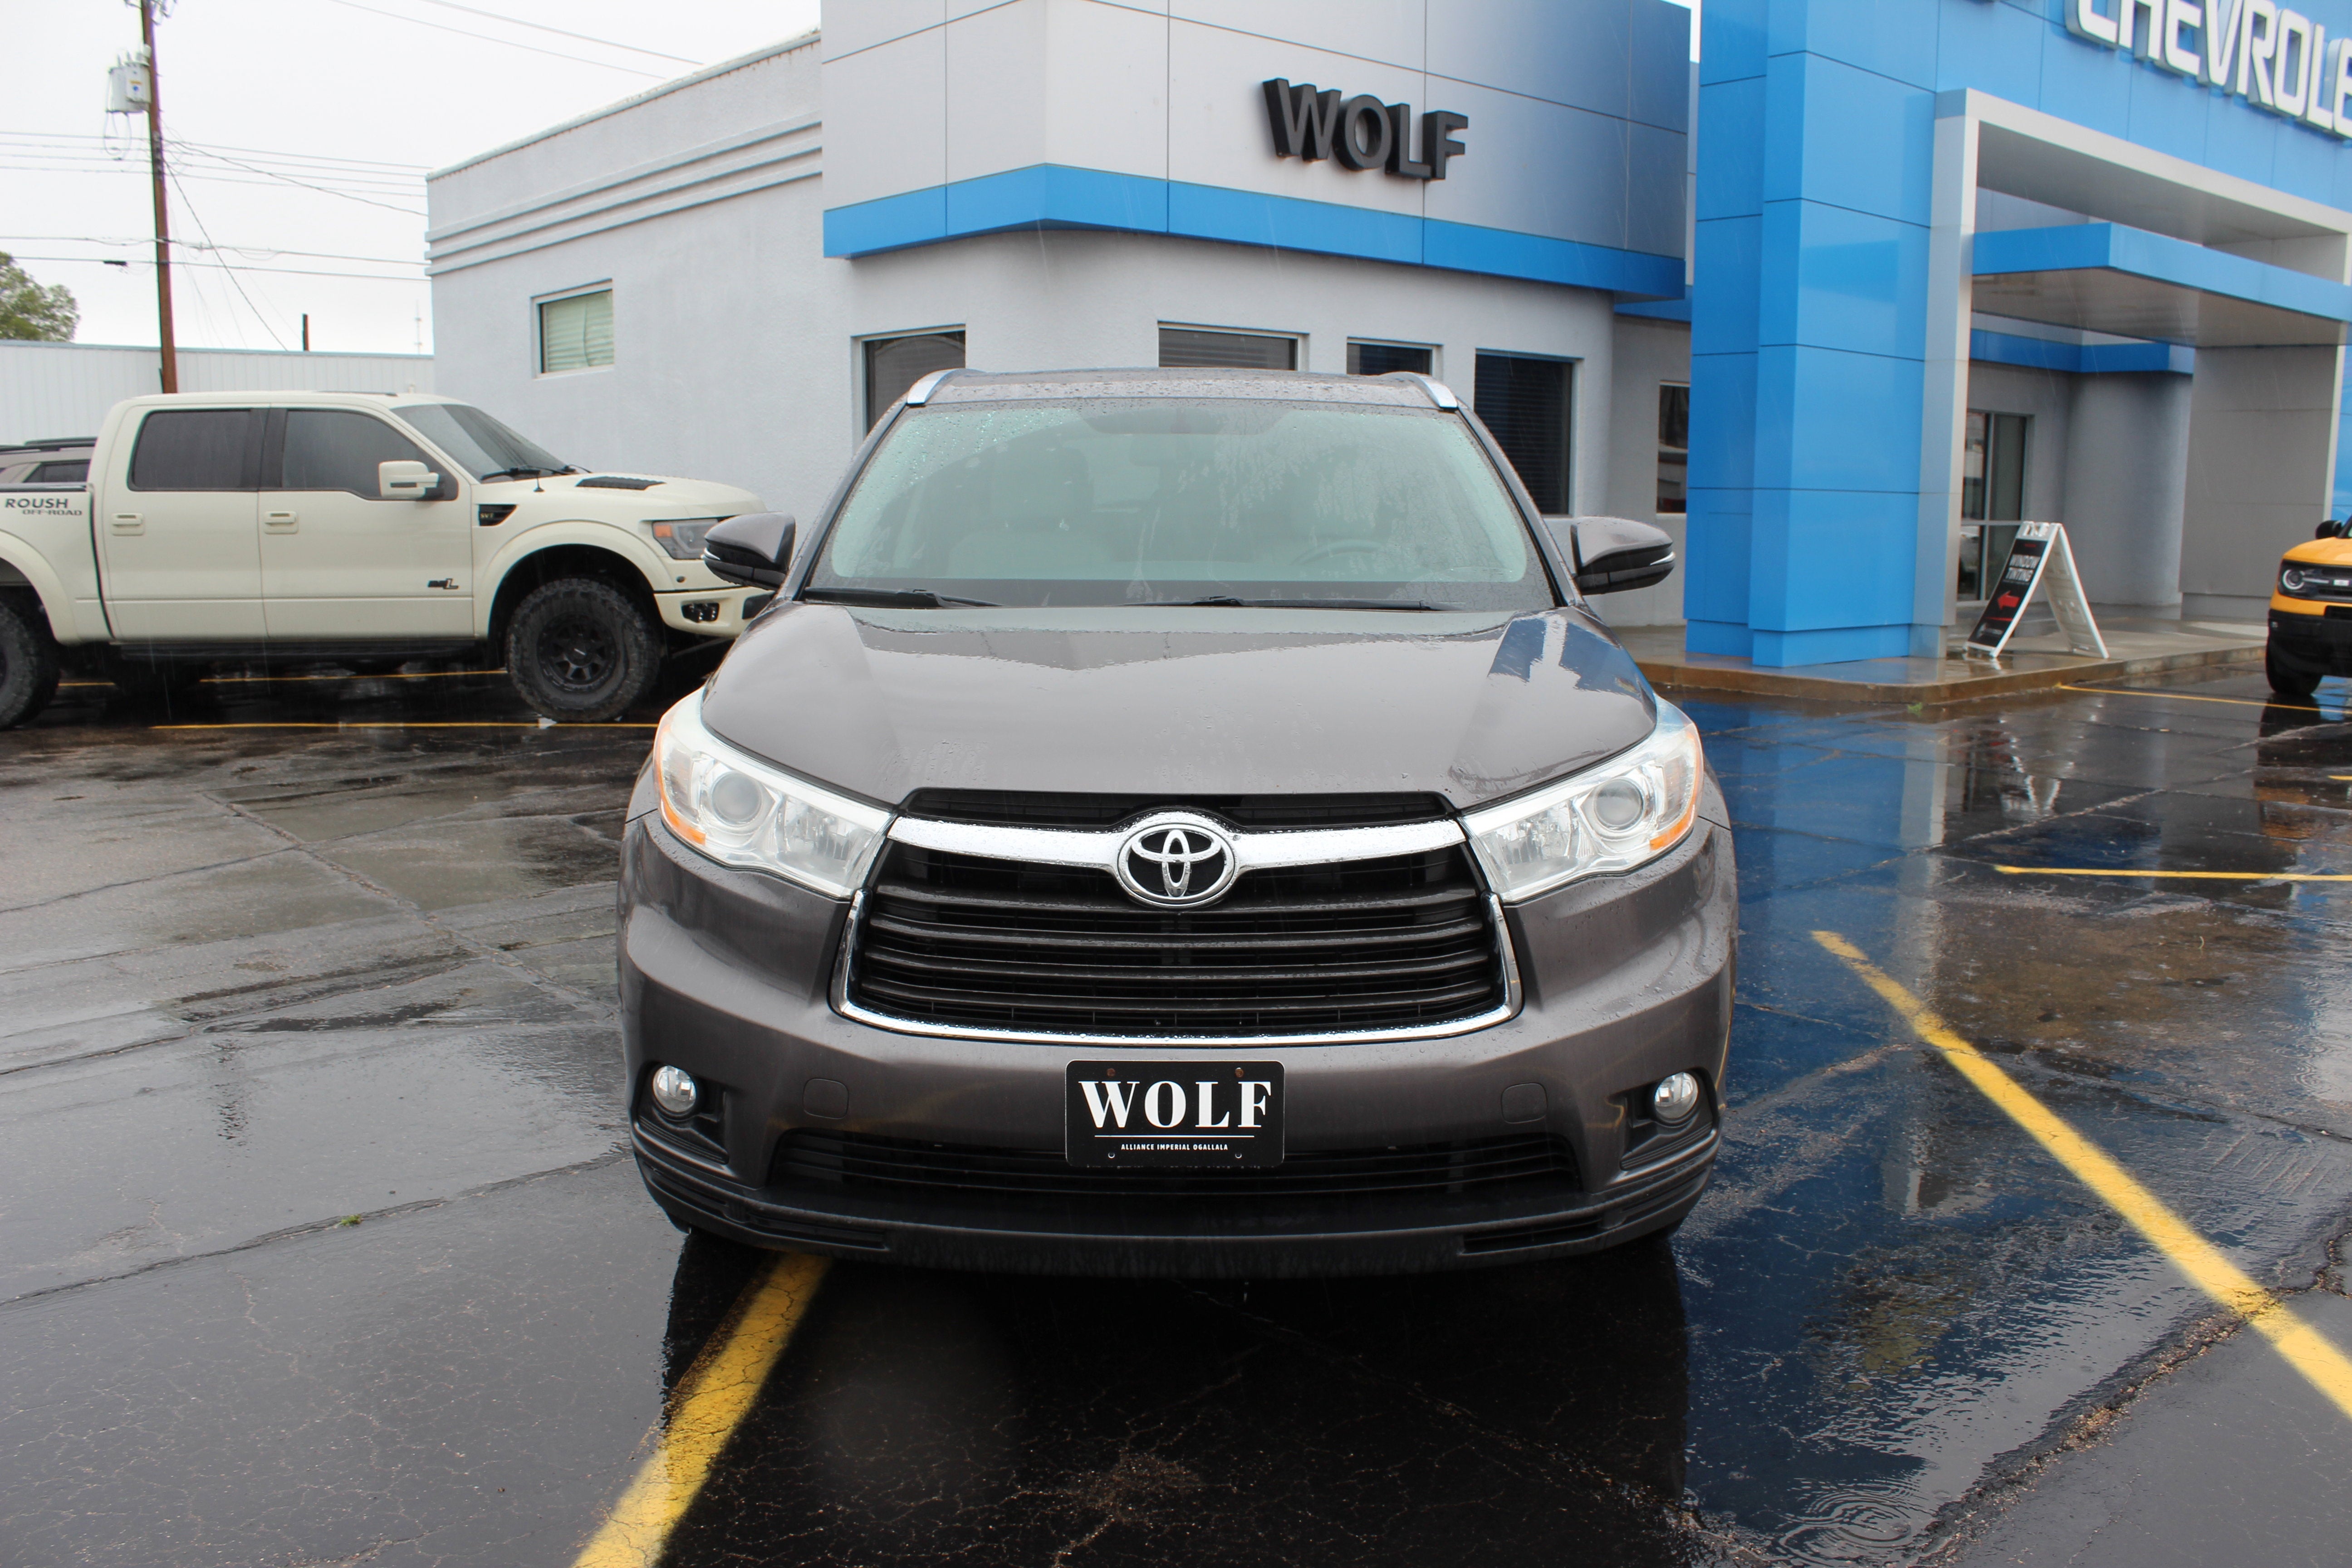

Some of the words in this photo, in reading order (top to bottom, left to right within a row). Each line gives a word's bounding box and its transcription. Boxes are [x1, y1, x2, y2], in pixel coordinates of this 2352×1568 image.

[1262, 78, 1468, 180] WOLF
[5, 498, 69, 508] ROUSH
[2009, 554, 2041, 569] WINDOW
[2005, 567, 2034, 582] TINTING
[1078, 1081, 1271, 1128] WOLF
